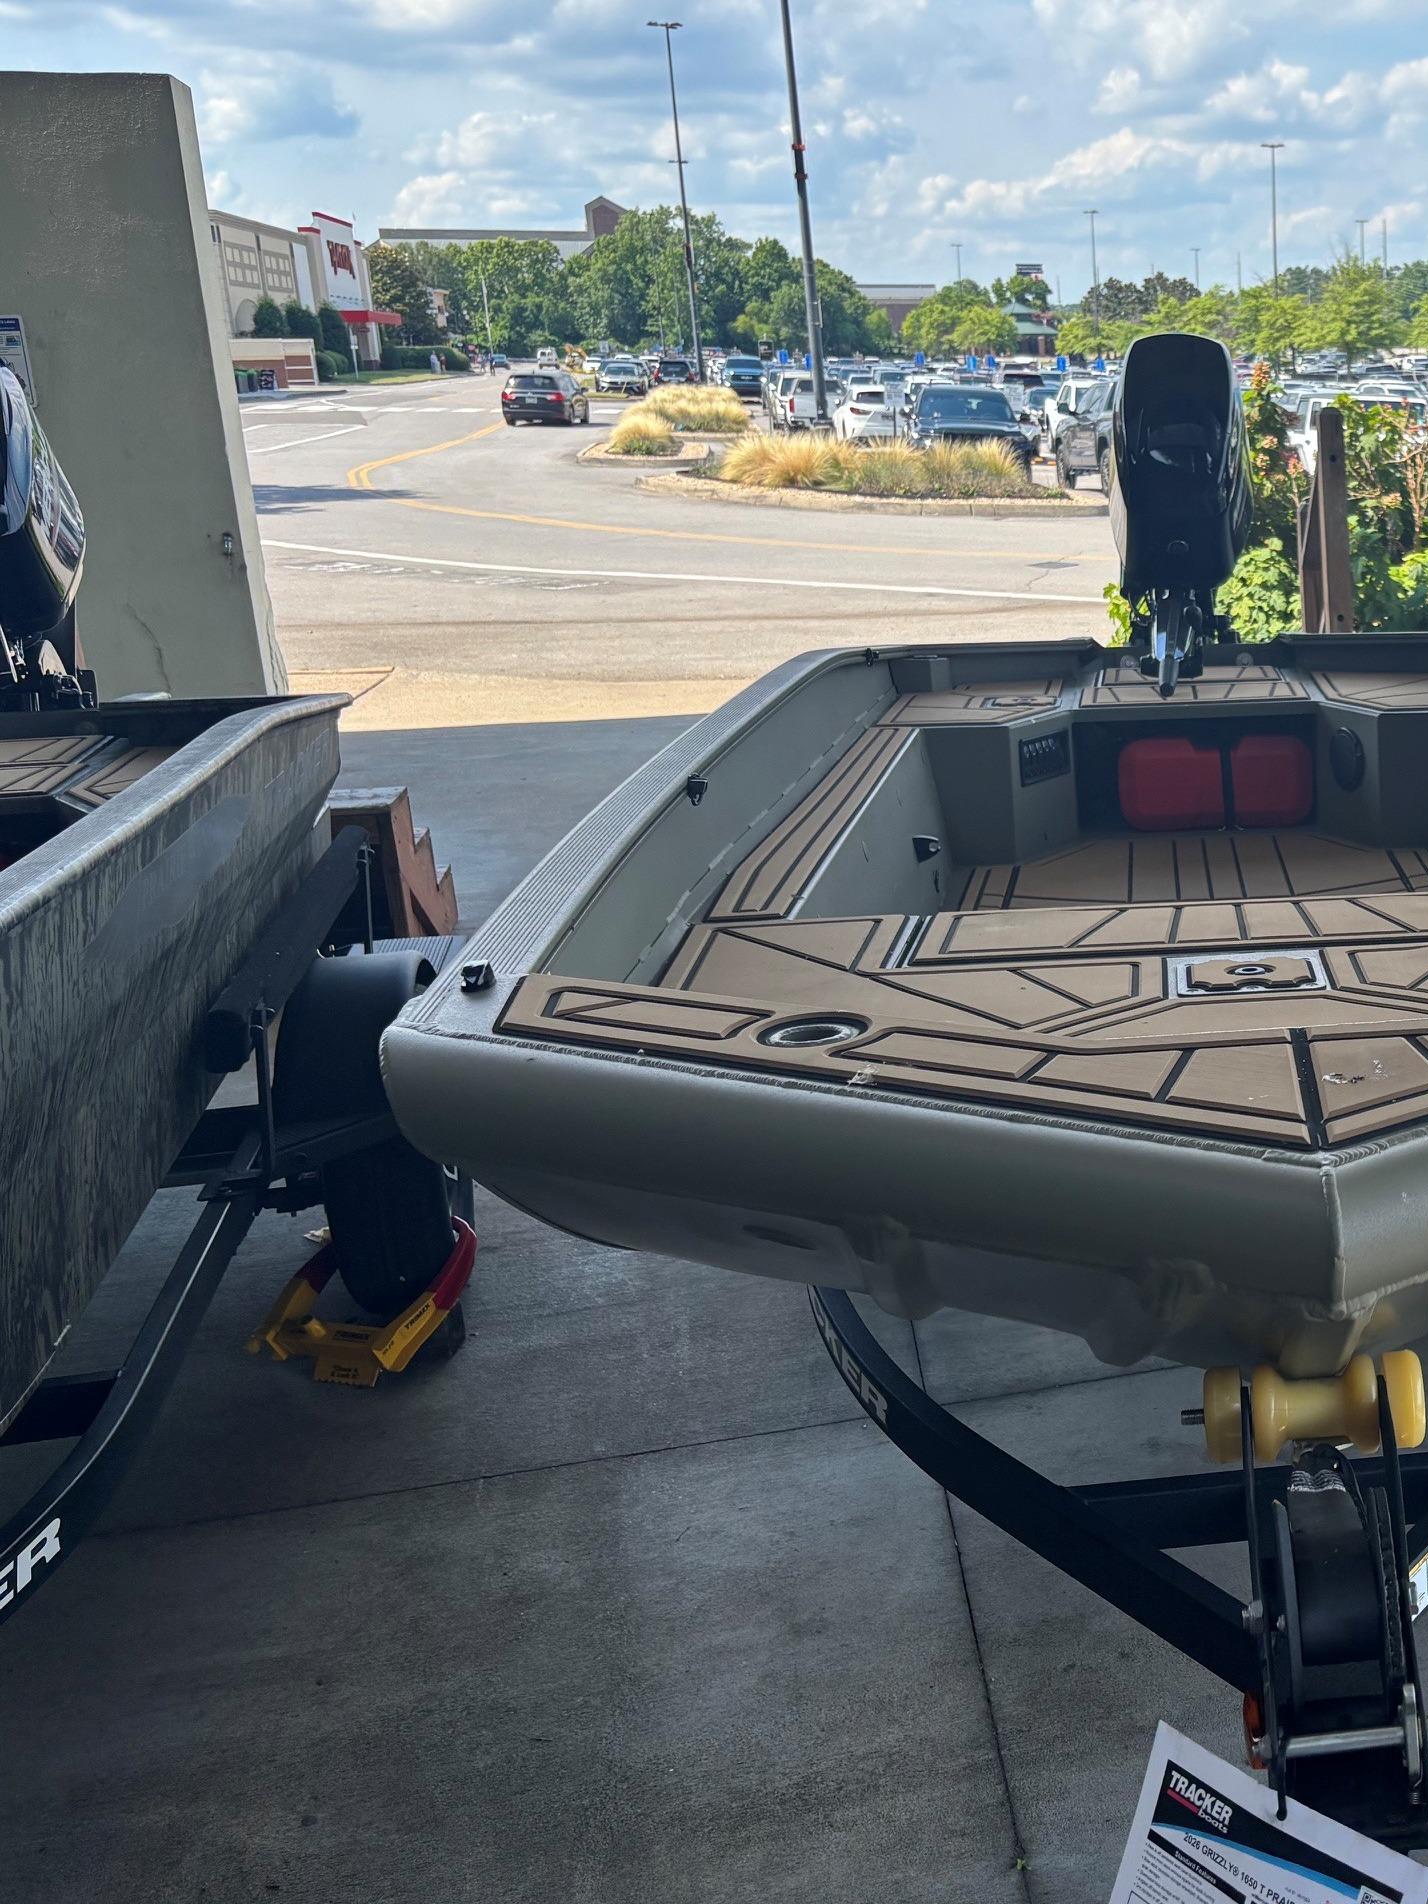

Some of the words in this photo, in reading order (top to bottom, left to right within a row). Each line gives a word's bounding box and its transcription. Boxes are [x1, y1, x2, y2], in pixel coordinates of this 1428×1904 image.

[1168, 1770, 1233, 1825] TRACKER
[1198, 1808, 1229, 1833] boats
[1183, 1832, 1201, 1850] 2026
[1241, 1872, 1258, 1890] 1650
[1260, 1883, 1266, 1894] T
